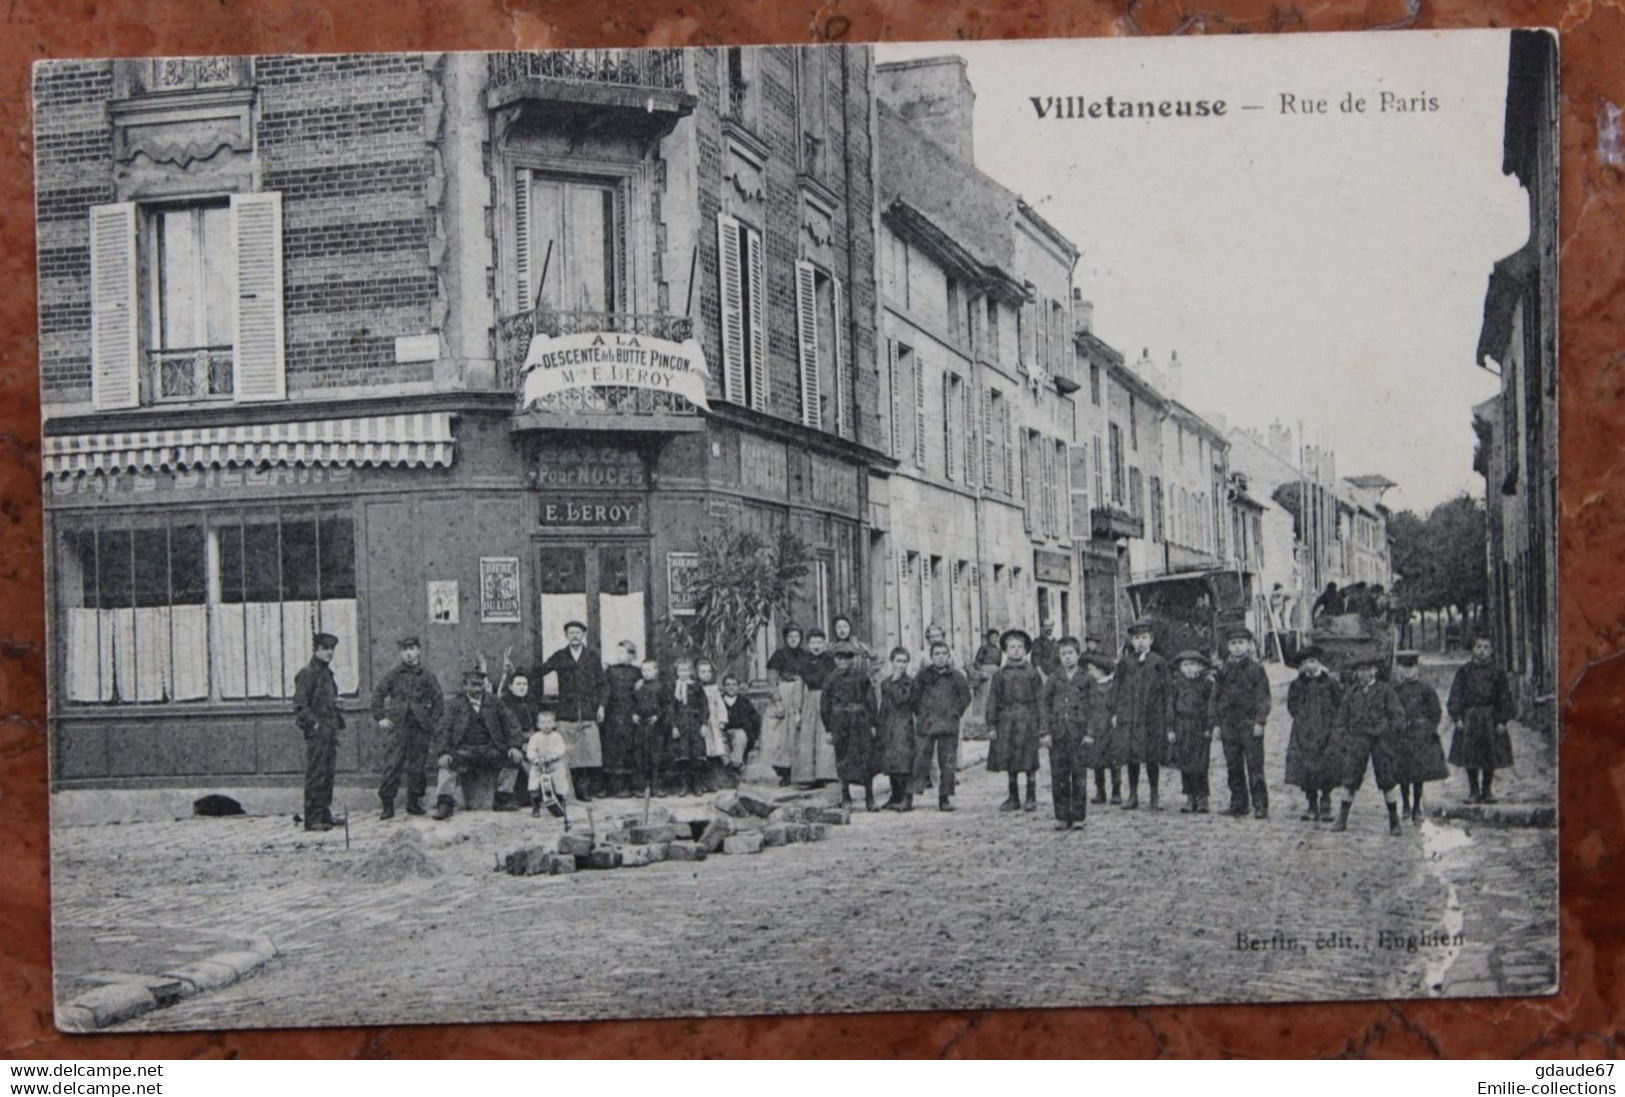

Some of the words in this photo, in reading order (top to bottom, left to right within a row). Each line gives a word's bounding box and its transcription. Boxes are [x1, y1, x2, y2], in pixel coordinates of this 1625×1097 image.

[1030, 96, 1228, 119] Villetaneuse
[1279, 93, 1329, 114] Rue
[1340, 92, 1367, 114] de
[1379, 92, 1440, 113] Paris
[591, 335, 606, 346] A
[616, 336, 641, 347] LA
[542, 348, 602, 370] DESCENTE
[616, 348, 647, 366] BUTTE
[610, 365, 675, 388] LEROY
[577, 466, 643, 484] NOCES
[546, 504, 564, 521] E.
[567, 502, 634, 521] LEROY
[484, 601, 495, 610] DU
[497, 600, 519, 610] LION
